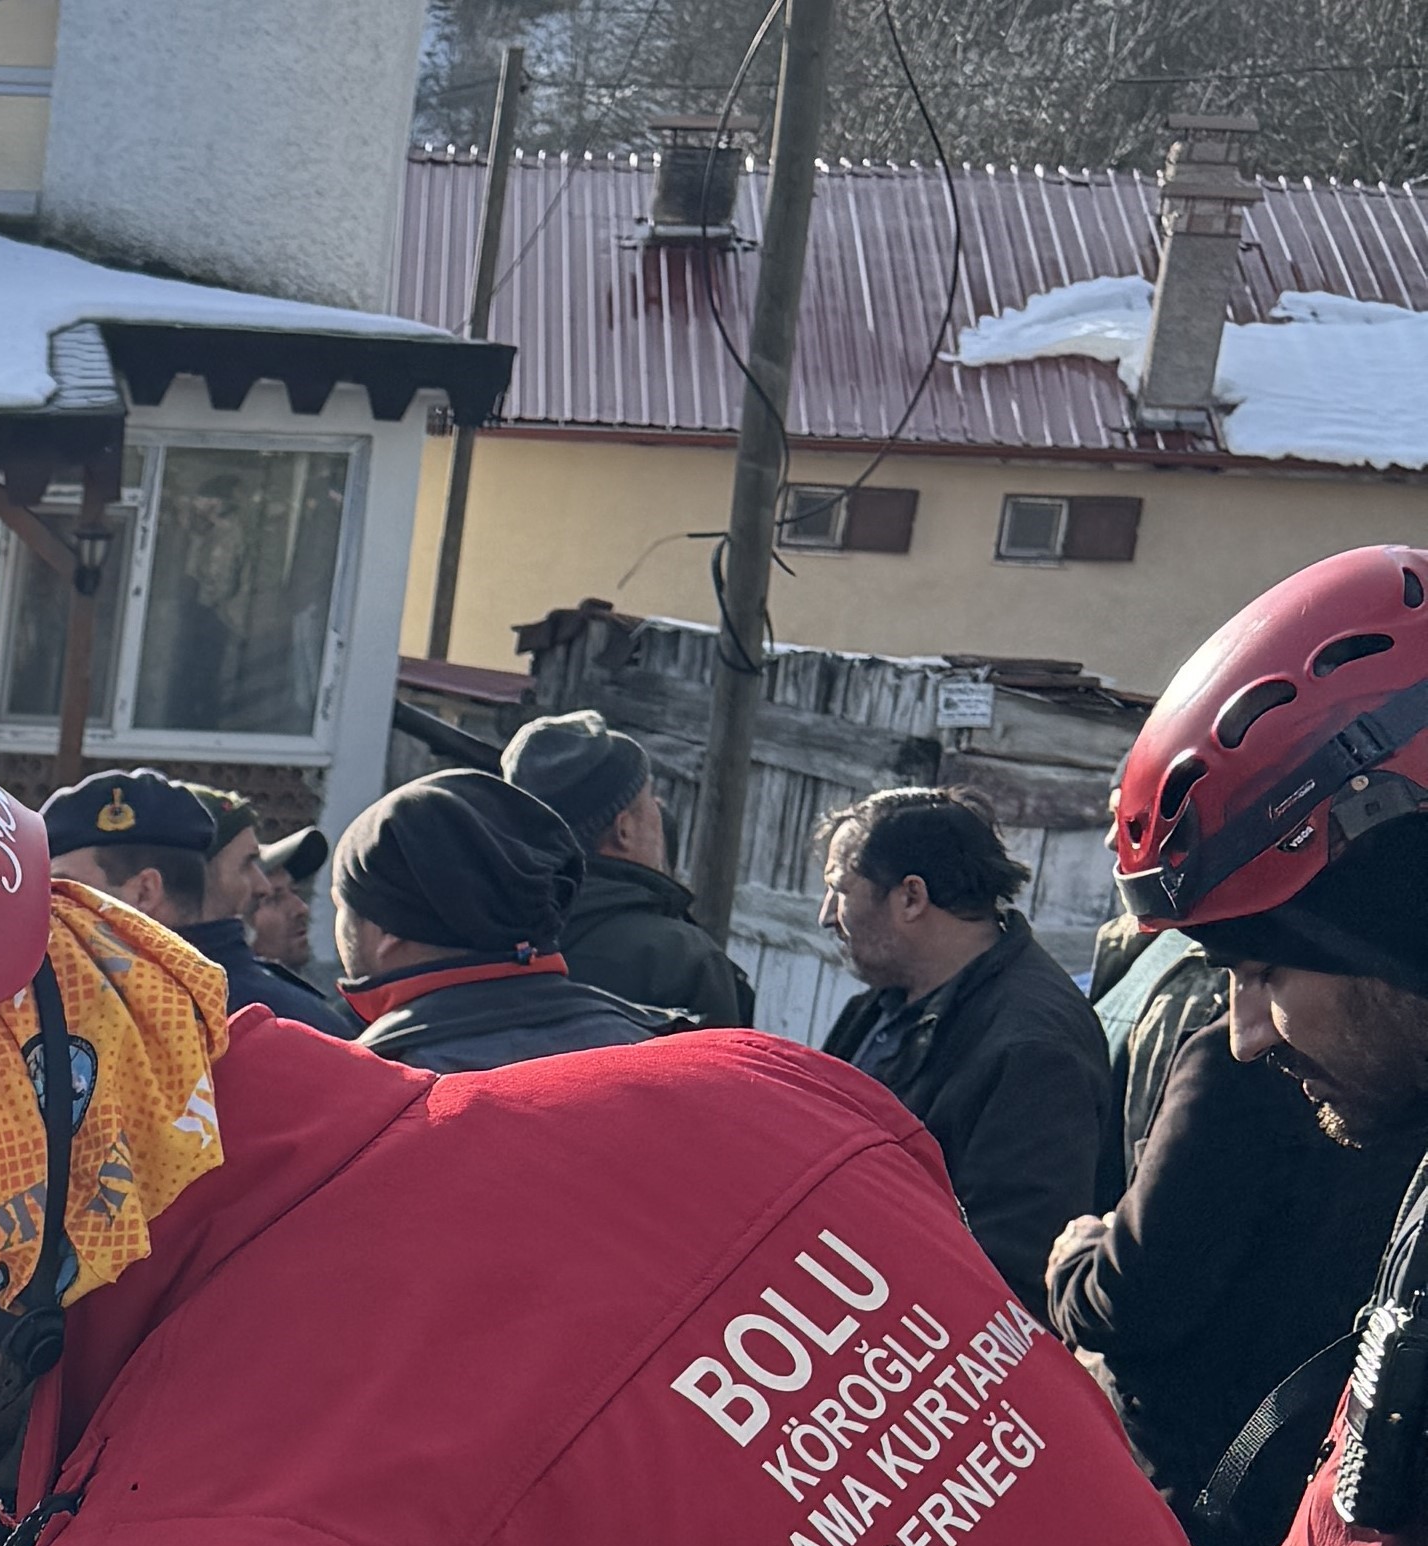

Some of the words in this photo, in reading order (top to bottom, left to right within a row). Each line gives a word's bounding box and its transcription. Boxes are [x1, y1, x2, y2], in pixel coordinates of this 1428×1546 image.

[670, 1228, 890, 1448] BOLU
[761, 1303, 951, 1503] KÖROĞLU
[866, 1299, 1046, 1490] KURTARMA
